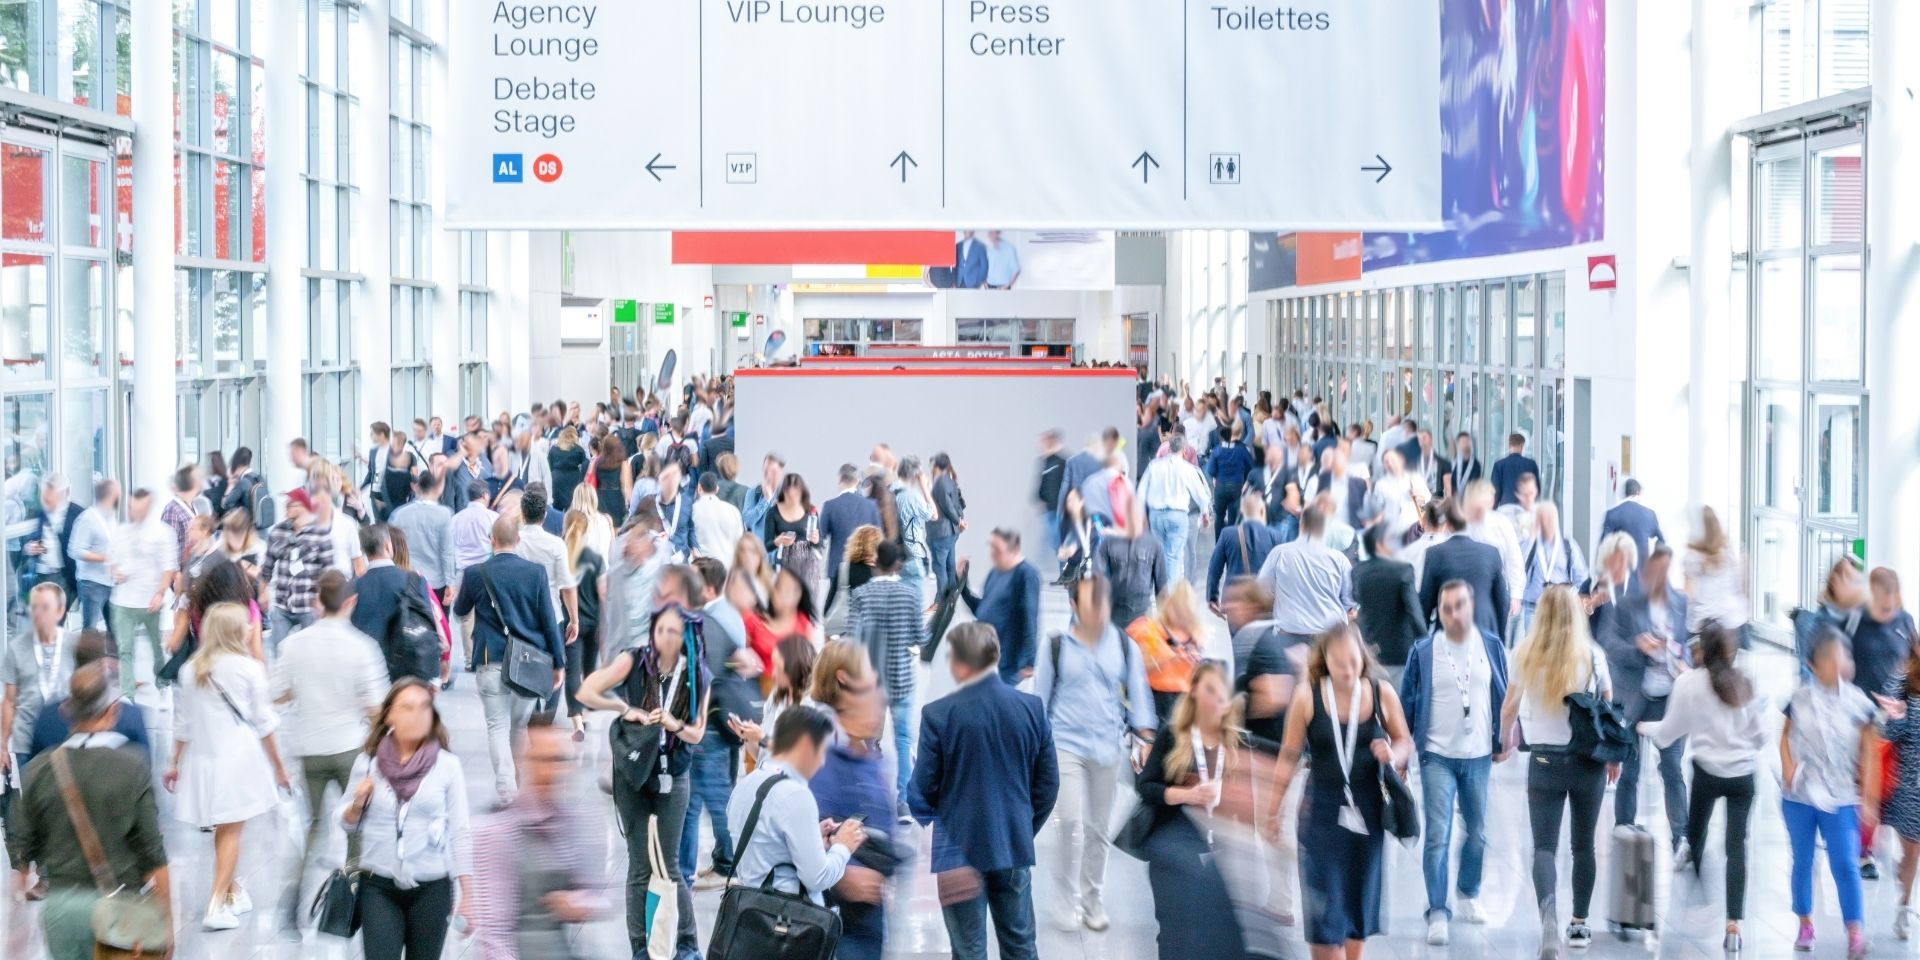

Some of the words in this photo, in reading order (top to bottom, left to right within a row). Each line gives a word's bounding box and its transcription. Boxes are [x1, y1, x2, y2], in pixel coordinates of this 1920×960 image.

[493, 0, 597, 29] Agency
[727, 0, 771, 23] VIP
[780, 0, 885, 29] Lounge
[970, 0, 1050, 23] Press
[1210, 6, 1330, 31] Toilettes
[494, 33, 599, 62] Lounge
[970, 32, 1066, 56] Center
[494, 75, 596, 101] Debate
[494, 109, 576, 138] Stage
[498, 161, 518, 176] AL
[538, 160, 557, 176] DS
[731, 163, 752, 174] VIP
